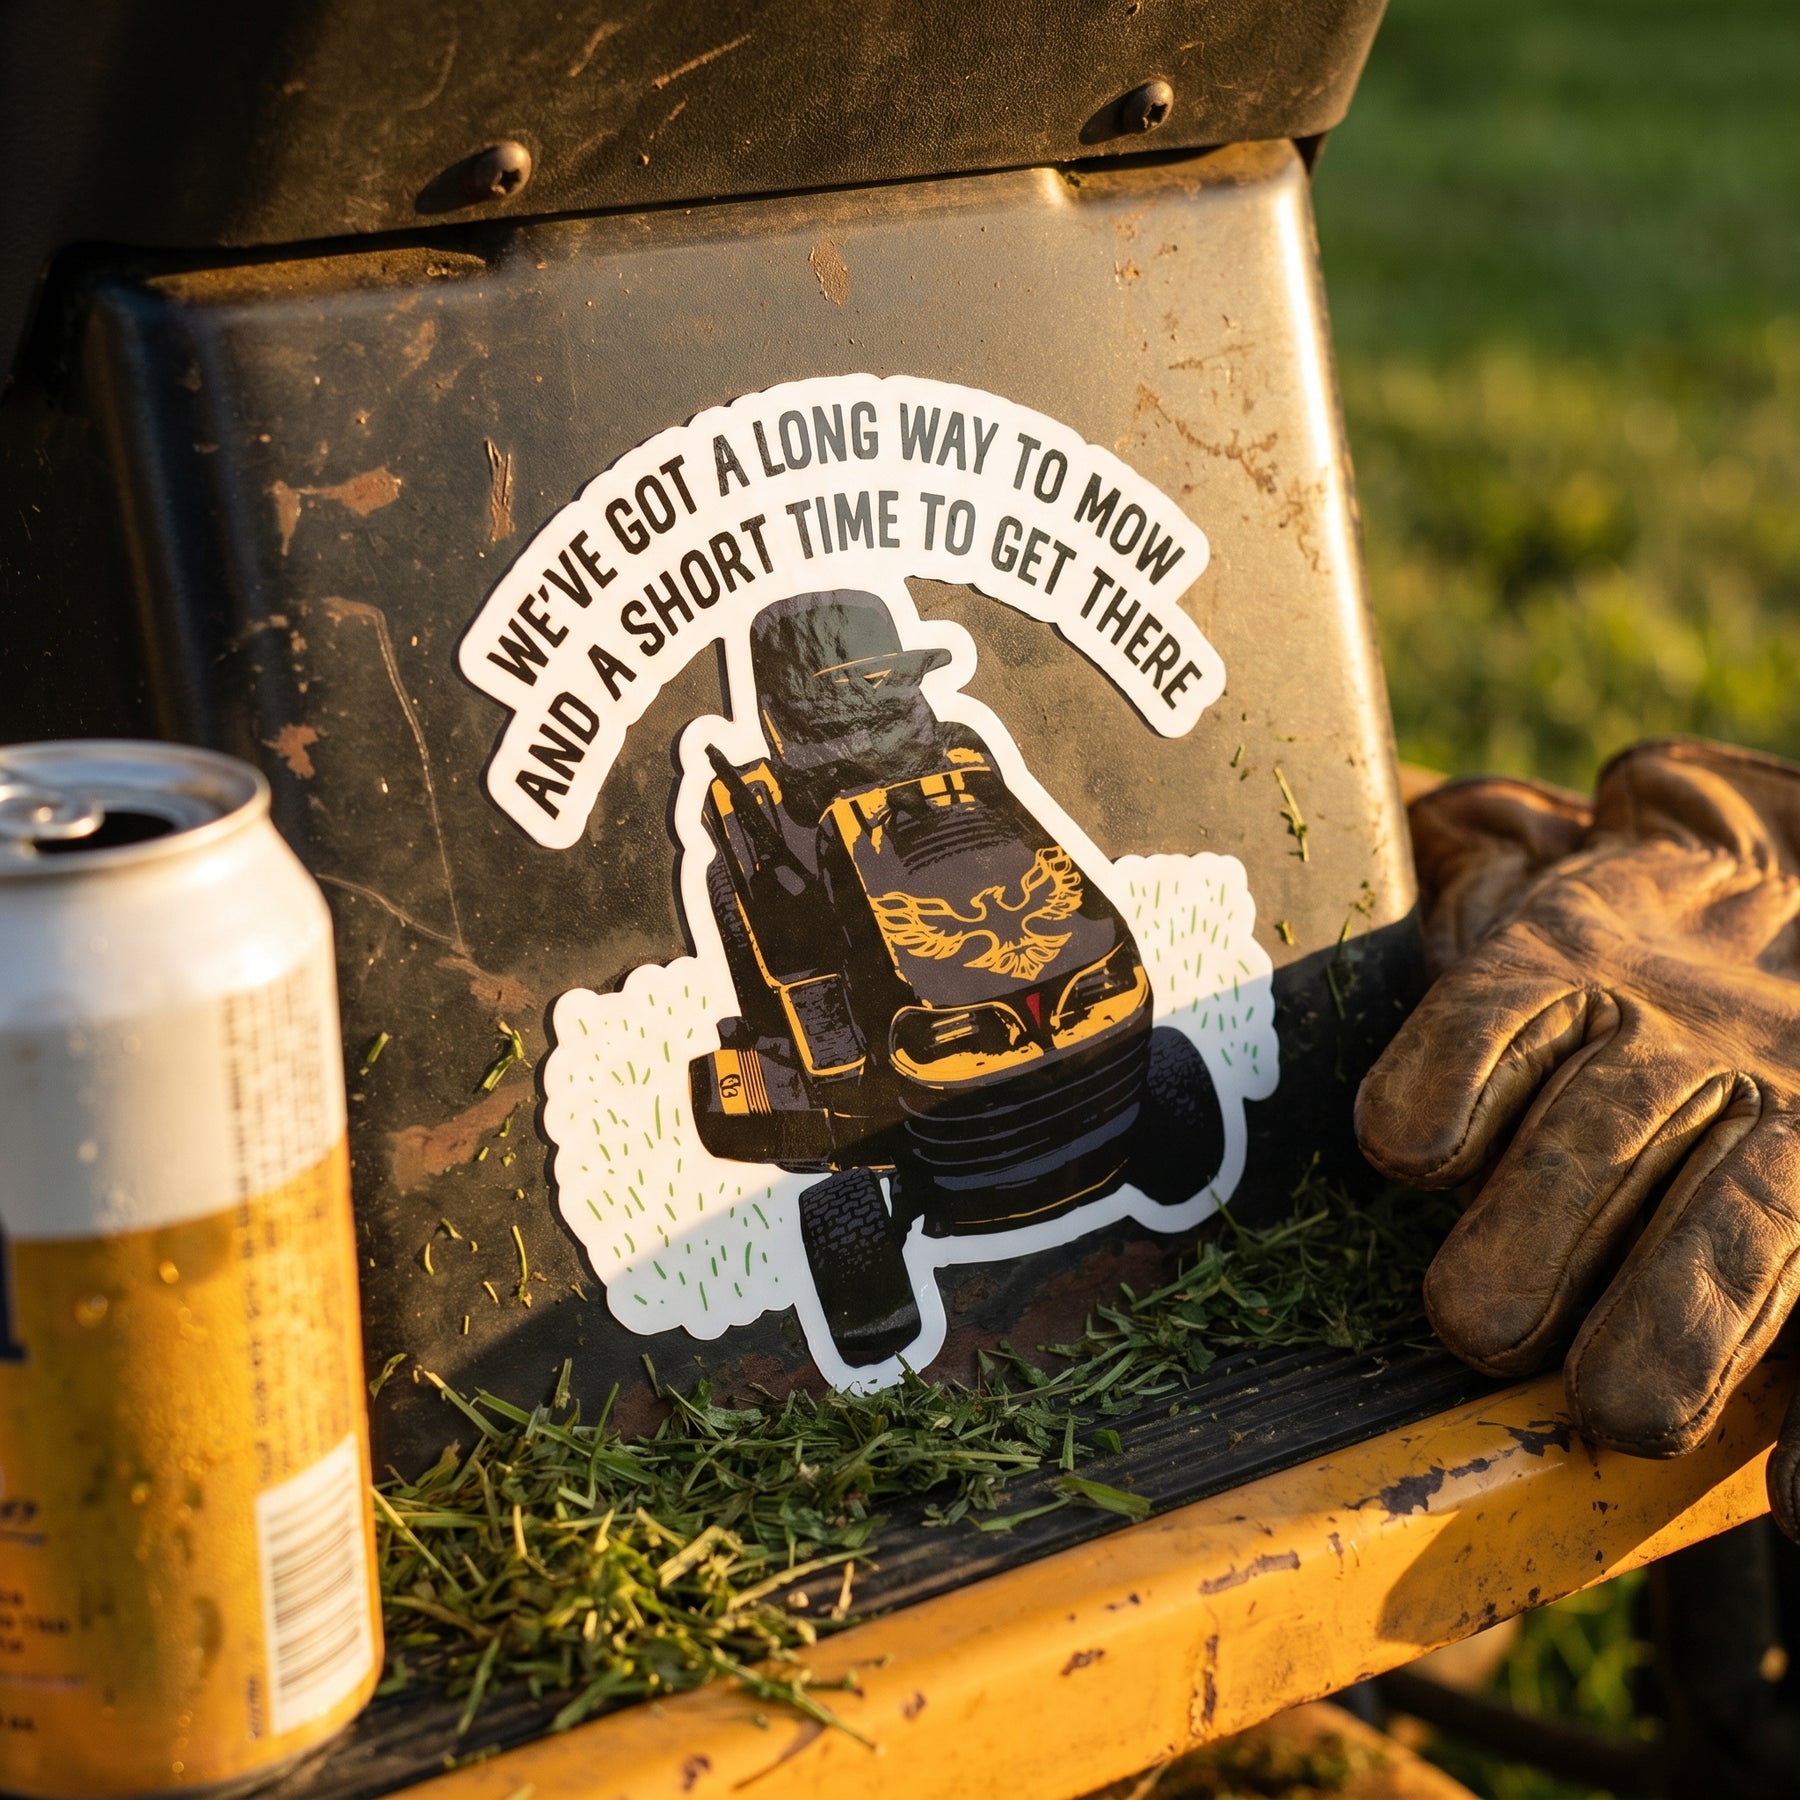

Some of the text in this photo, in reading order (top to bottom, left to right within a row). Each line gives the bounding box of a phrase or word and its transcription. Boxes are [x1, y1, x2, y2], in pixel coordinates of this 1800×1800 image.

[486, 402, 1186, 687] WE'VE GOT A LONG WAY TO MOW
[514, 490, 1203, 820] AND A SHORT TIME TO GET THERE
